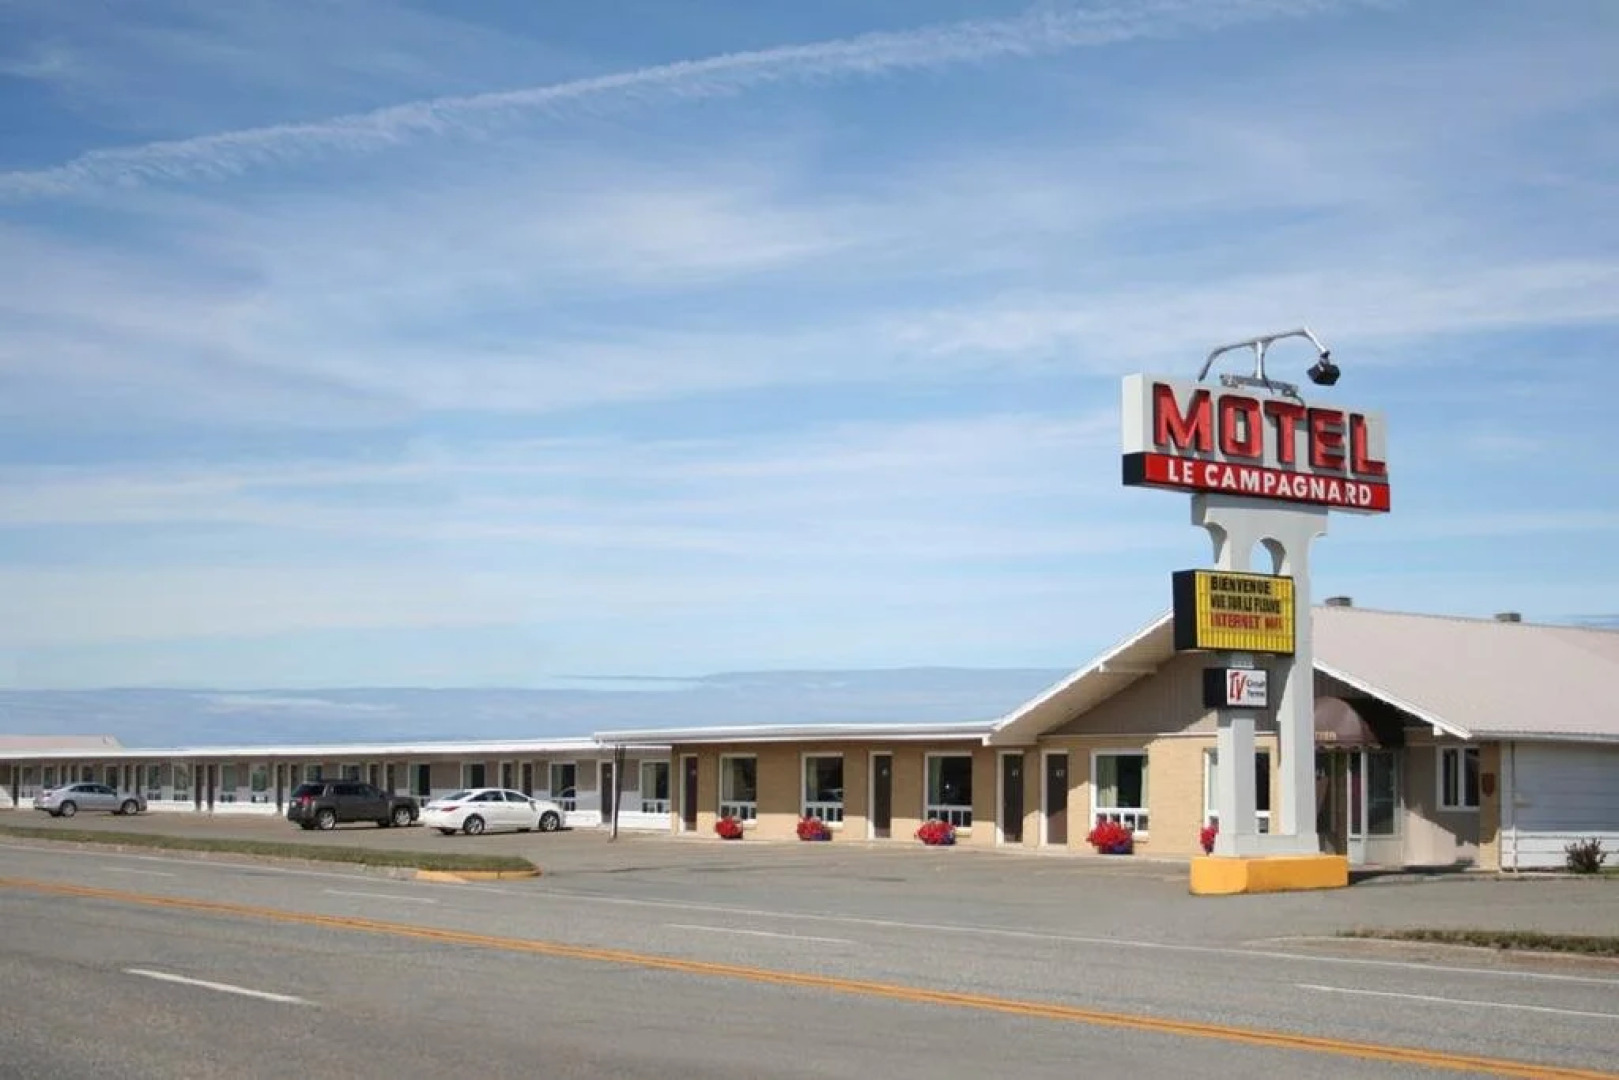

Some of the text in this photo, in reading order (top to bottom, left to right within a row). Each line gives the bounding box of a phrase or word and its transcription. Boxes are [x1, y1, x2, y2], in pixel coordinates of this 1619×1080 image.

[1153, 383, 1385, 476] MOTEL
[1167, 460, 1372, 505] LE CAMPAGNARD
[1229, 671, 1247, 701] TV
